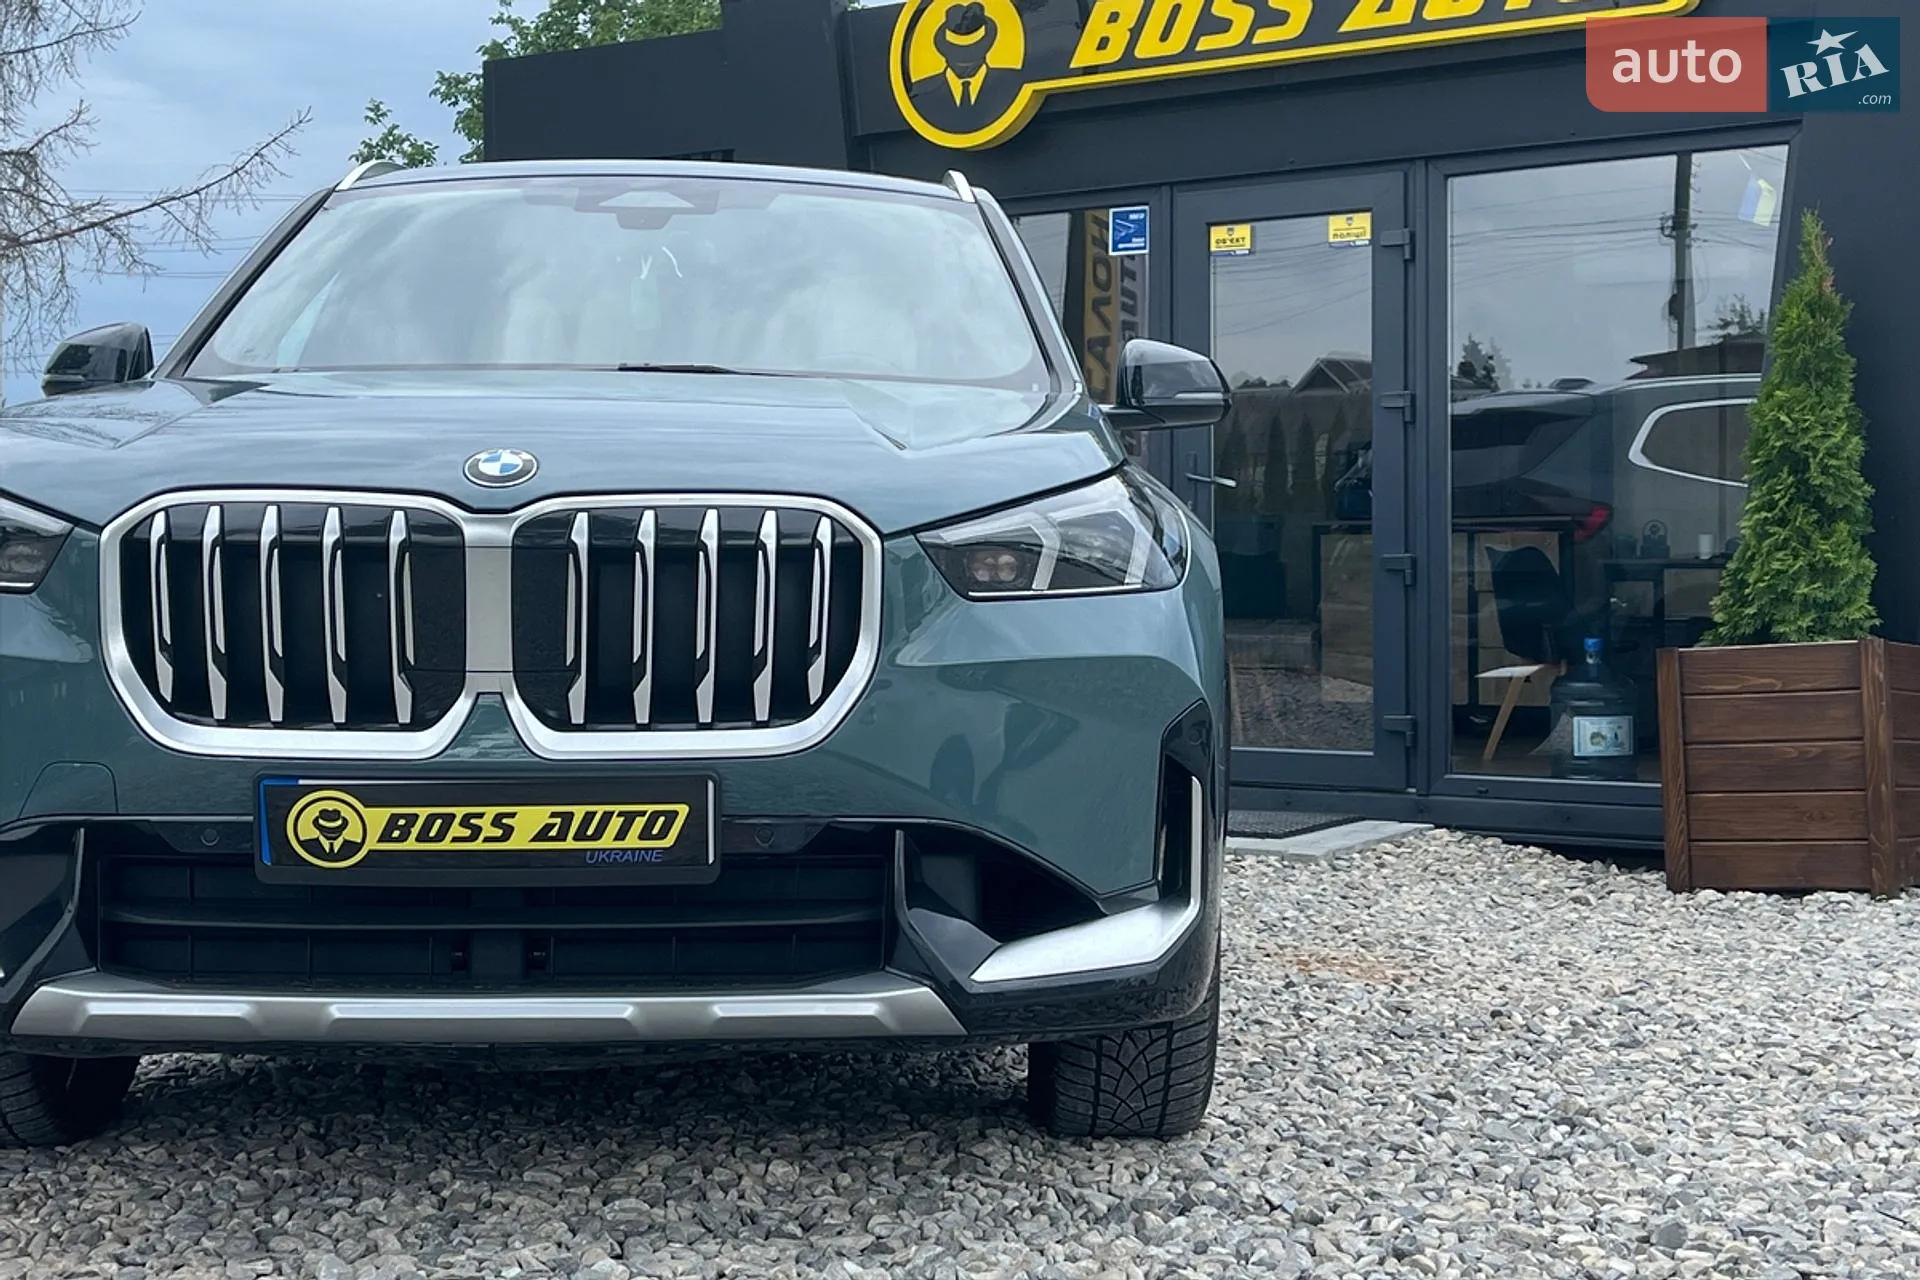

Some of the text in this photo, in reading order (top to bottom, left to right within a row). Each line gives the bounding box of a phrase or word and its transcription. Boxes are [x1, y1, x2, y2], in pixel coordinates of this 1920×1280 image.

[1069, 0, 1313, 68] BOSS
[376, 810, 680, 843] BOSS AUTO
[585, 849, 665, 864] UKRAINE
